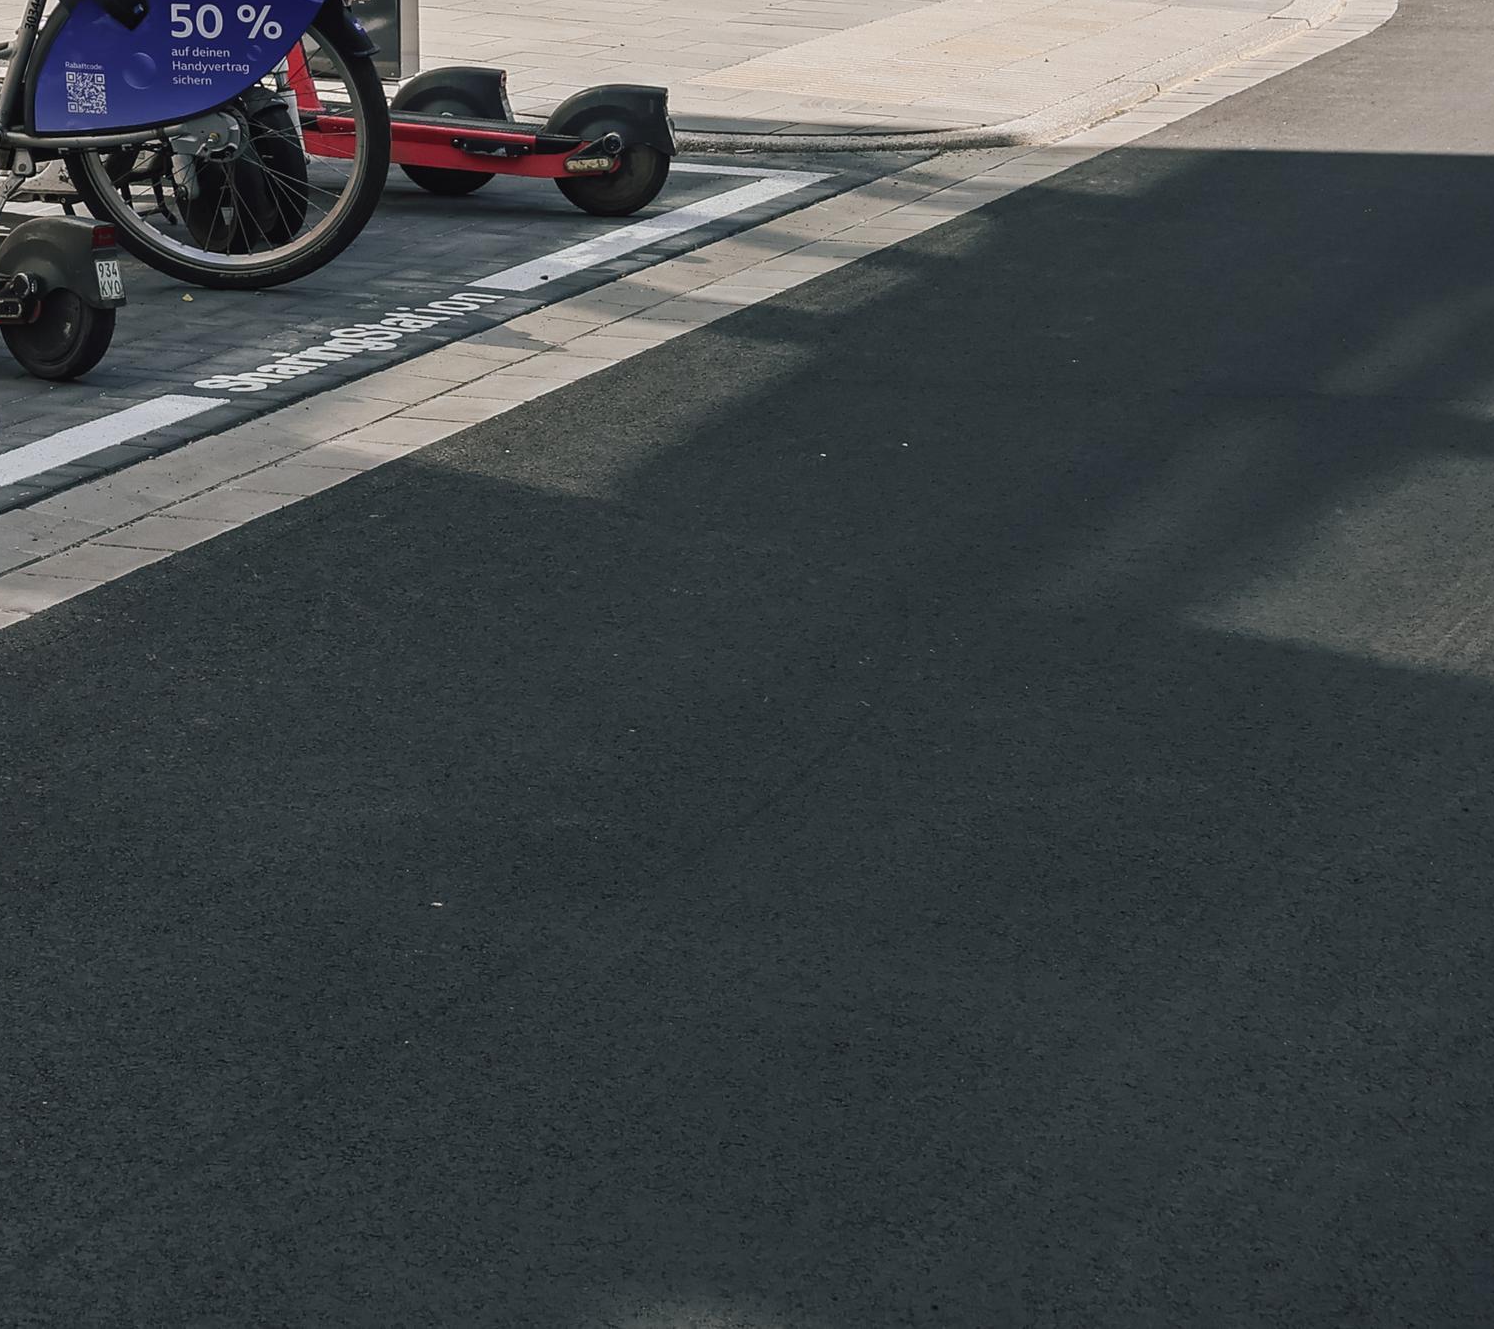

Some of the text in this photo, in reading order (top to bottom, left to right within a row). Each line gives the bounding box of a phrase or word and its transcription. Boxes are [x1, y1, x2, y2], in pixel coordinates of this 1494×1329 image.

[170, 3, 283, 40] 50 %
[171, 46, 231, 58] auf deinen
[172, 61, 250, 75] Handyvertrag
[172, 75, 213, 86] sichern
[98, 262, 117, 278] 934
[100, 279, 121, 296] KYO
